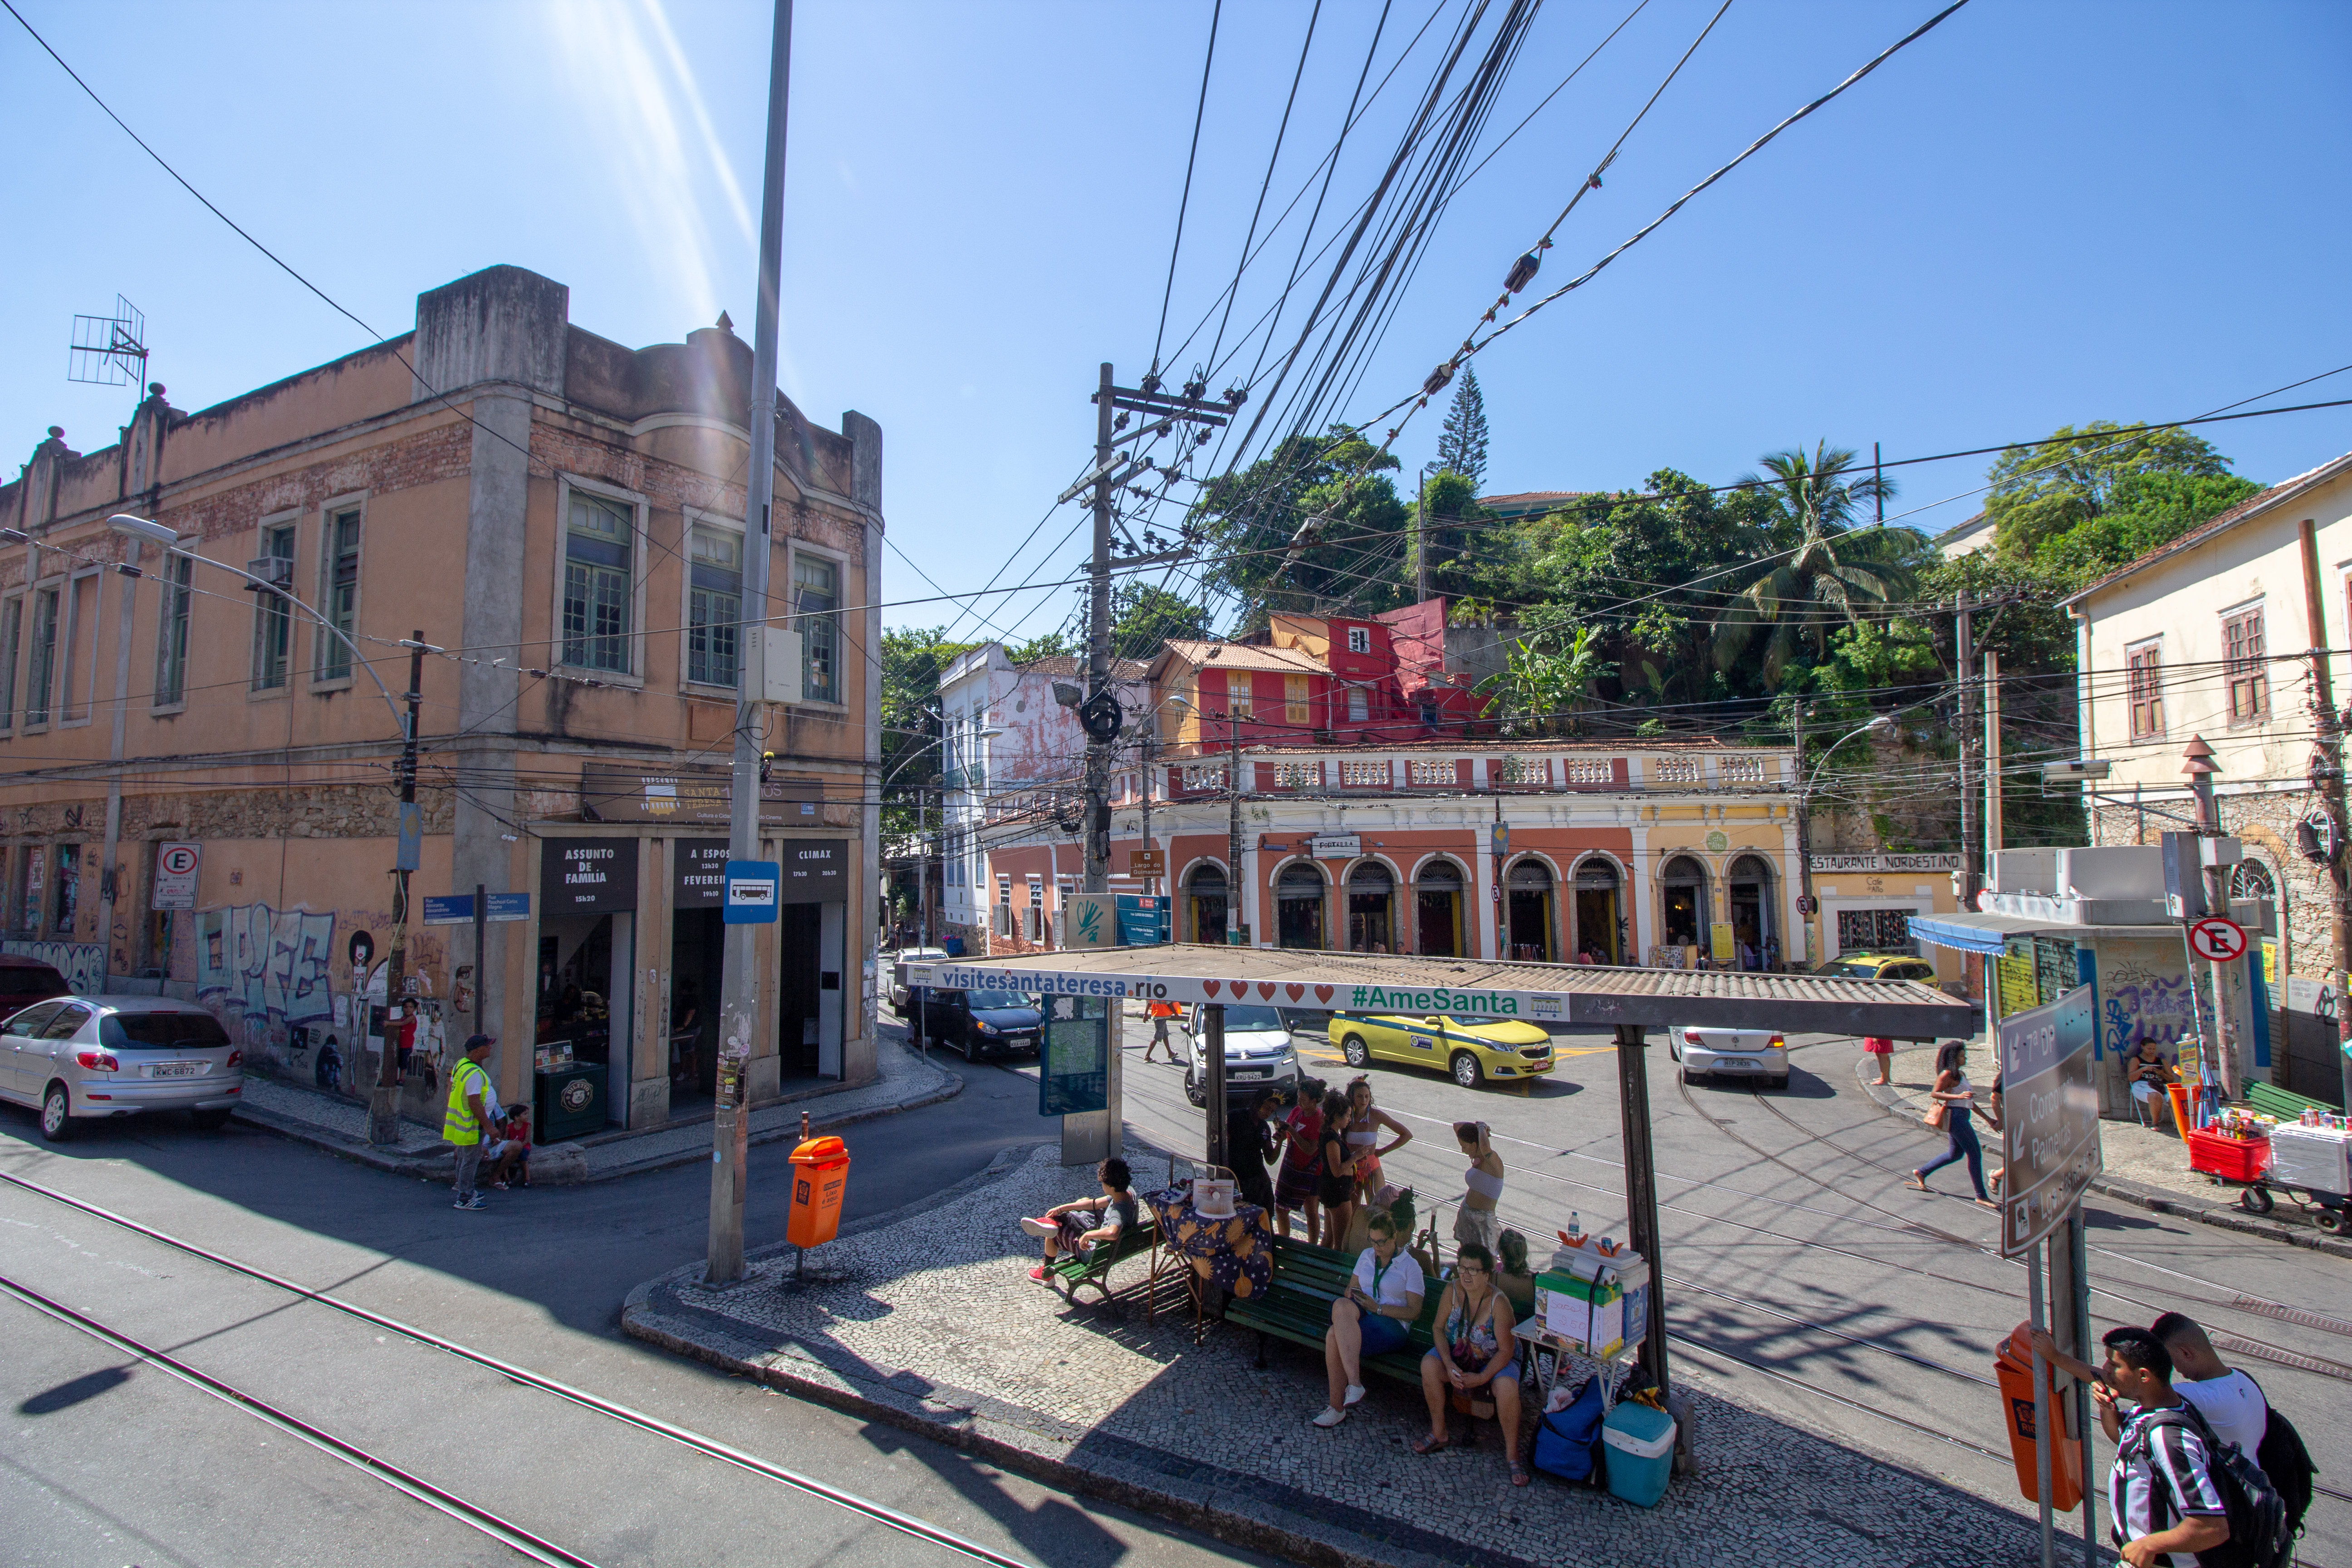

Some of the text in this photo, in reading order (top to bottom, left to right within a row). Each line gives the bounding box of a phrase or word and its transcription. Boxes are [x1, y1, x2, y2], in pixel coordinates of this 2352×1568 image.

[684, 787, 720, 797] SANTA
[685, 799, 722, 809] TERESA
[565, 849, 614, 860] ASSUNTO
[691, 849, 730, 858] A ESPOS
[799, 850, 831, 859] CLIMAX
[173, 853, 187, 868] E
[1810, 855, 1959, 868] ESTAURANTE NORDESTINO
[578, 862, 591, 872] DE
[684, 876, 725, 885] FEVEREI
[2208, 928, 2229, 953] E
[943, 967, 1167, 999] visitesantateresa.rio
[1352, 985, 1518, 1014] #AmeSanta
[2042, 1024, 2055, 1057] DP
[157, 1068, 195, 1076] KWC-6872
[2032, 1121, 2071, 1169] Paineiras
